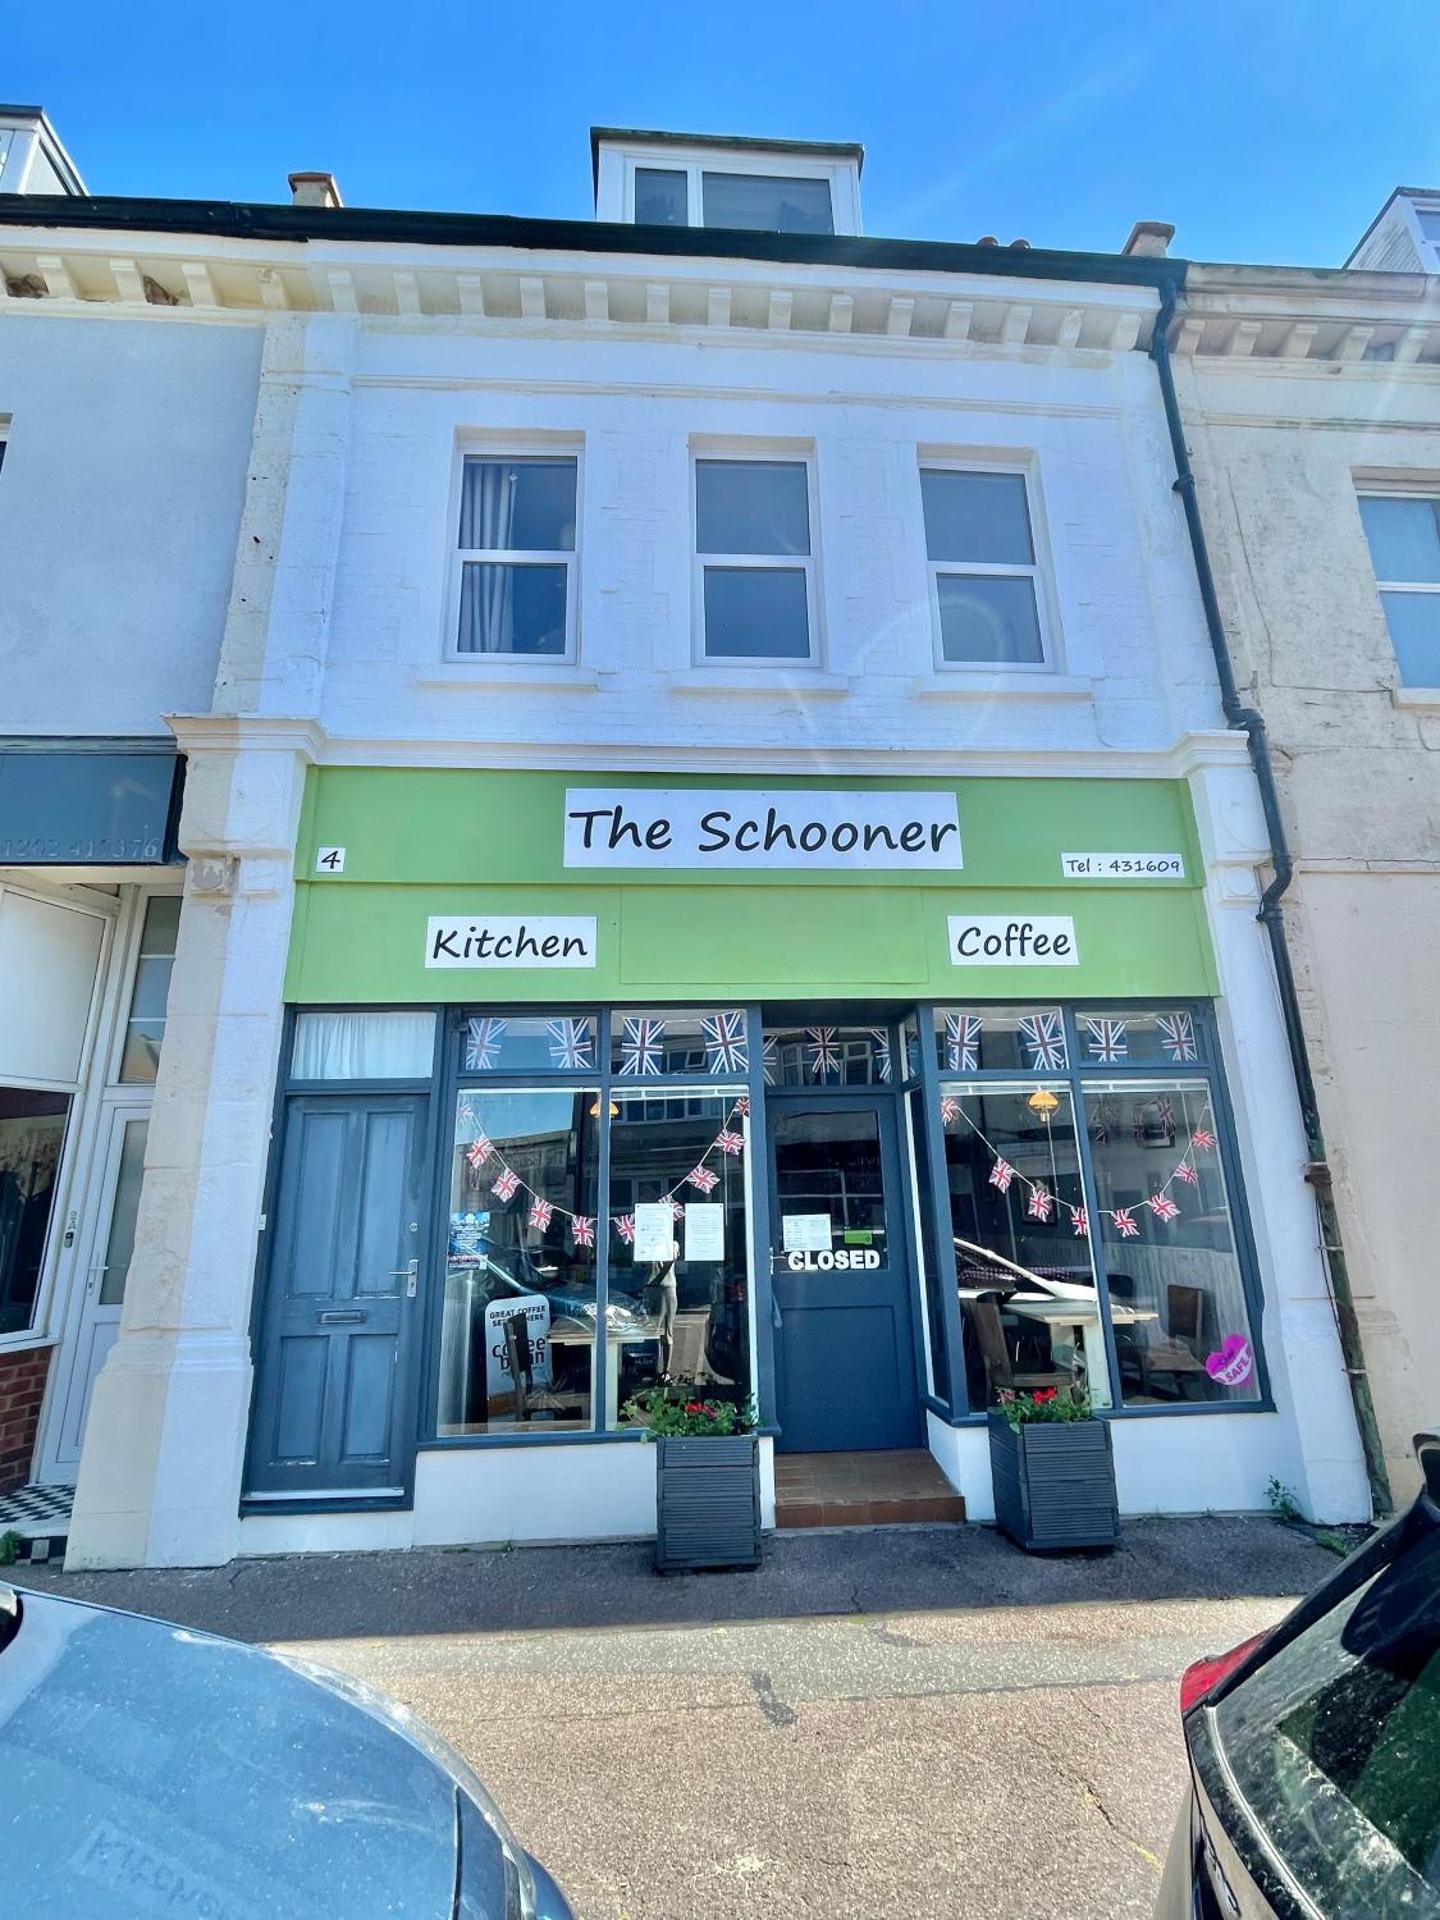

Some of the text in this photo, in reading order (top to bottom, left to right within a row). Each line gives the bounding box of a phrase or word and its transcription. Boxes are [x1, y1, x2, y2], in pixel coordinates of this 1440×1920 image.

[568, 804, 957, 852] The Schooner
[321, 850, 341, 869] 4
[1066, 859, 1090, 873] Tel
[1109, 860, 1180, 873] 431609
[433, 926, 588, 960] Kitchen
[957, 923, 1071, 957] Coffee
[787, 1250, 880, 1271] CLOSED
[489, 1305, 546, 1319] GREAT COFFEE
[1225, 1357, 1249, 1382] SAFE
